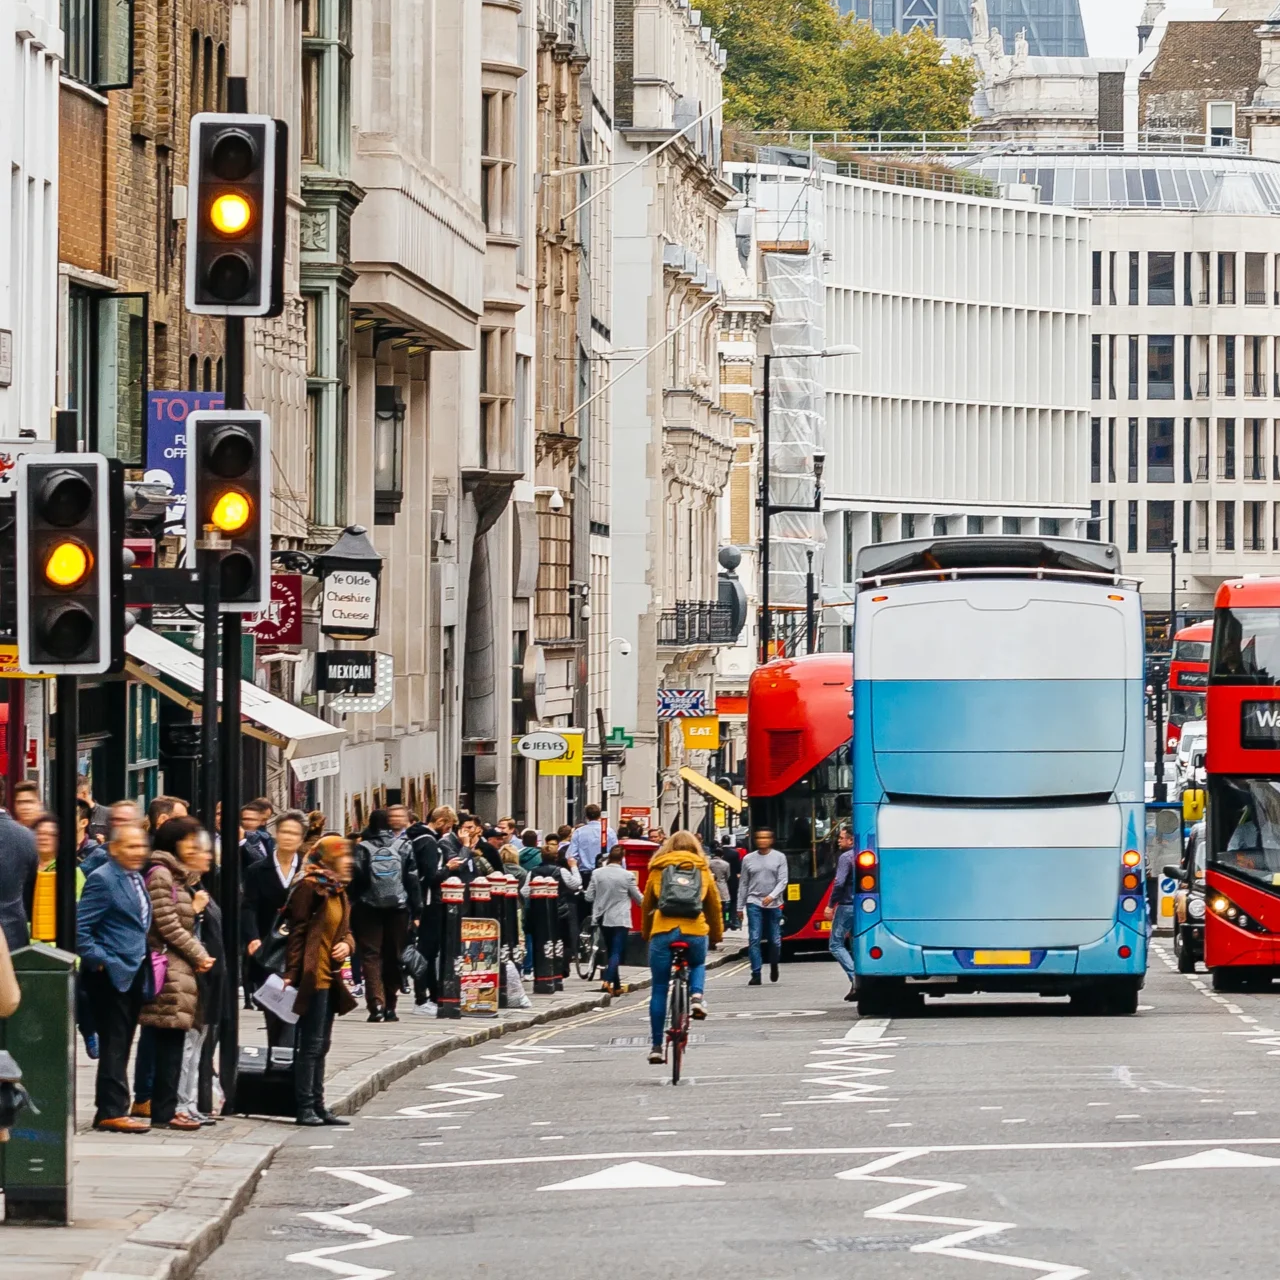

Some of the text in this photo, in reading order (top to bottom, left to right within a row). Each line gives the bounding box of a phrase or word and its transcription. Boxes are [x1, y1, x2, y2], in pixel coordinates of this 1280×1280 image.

[333, 574, 371, 586] Ye Olde
[271, 580, 297, 607] COFFEE
[326, 591, 371, 603] Cheshire
[332, 609, 370, 620] Cheese
[276, 617, 295, 637] FOOD
[328, 664, 372, 679] MEXICAN
[689, 726, 714, 736] EAT.
[532, 741, 565, 751] JEEVES
